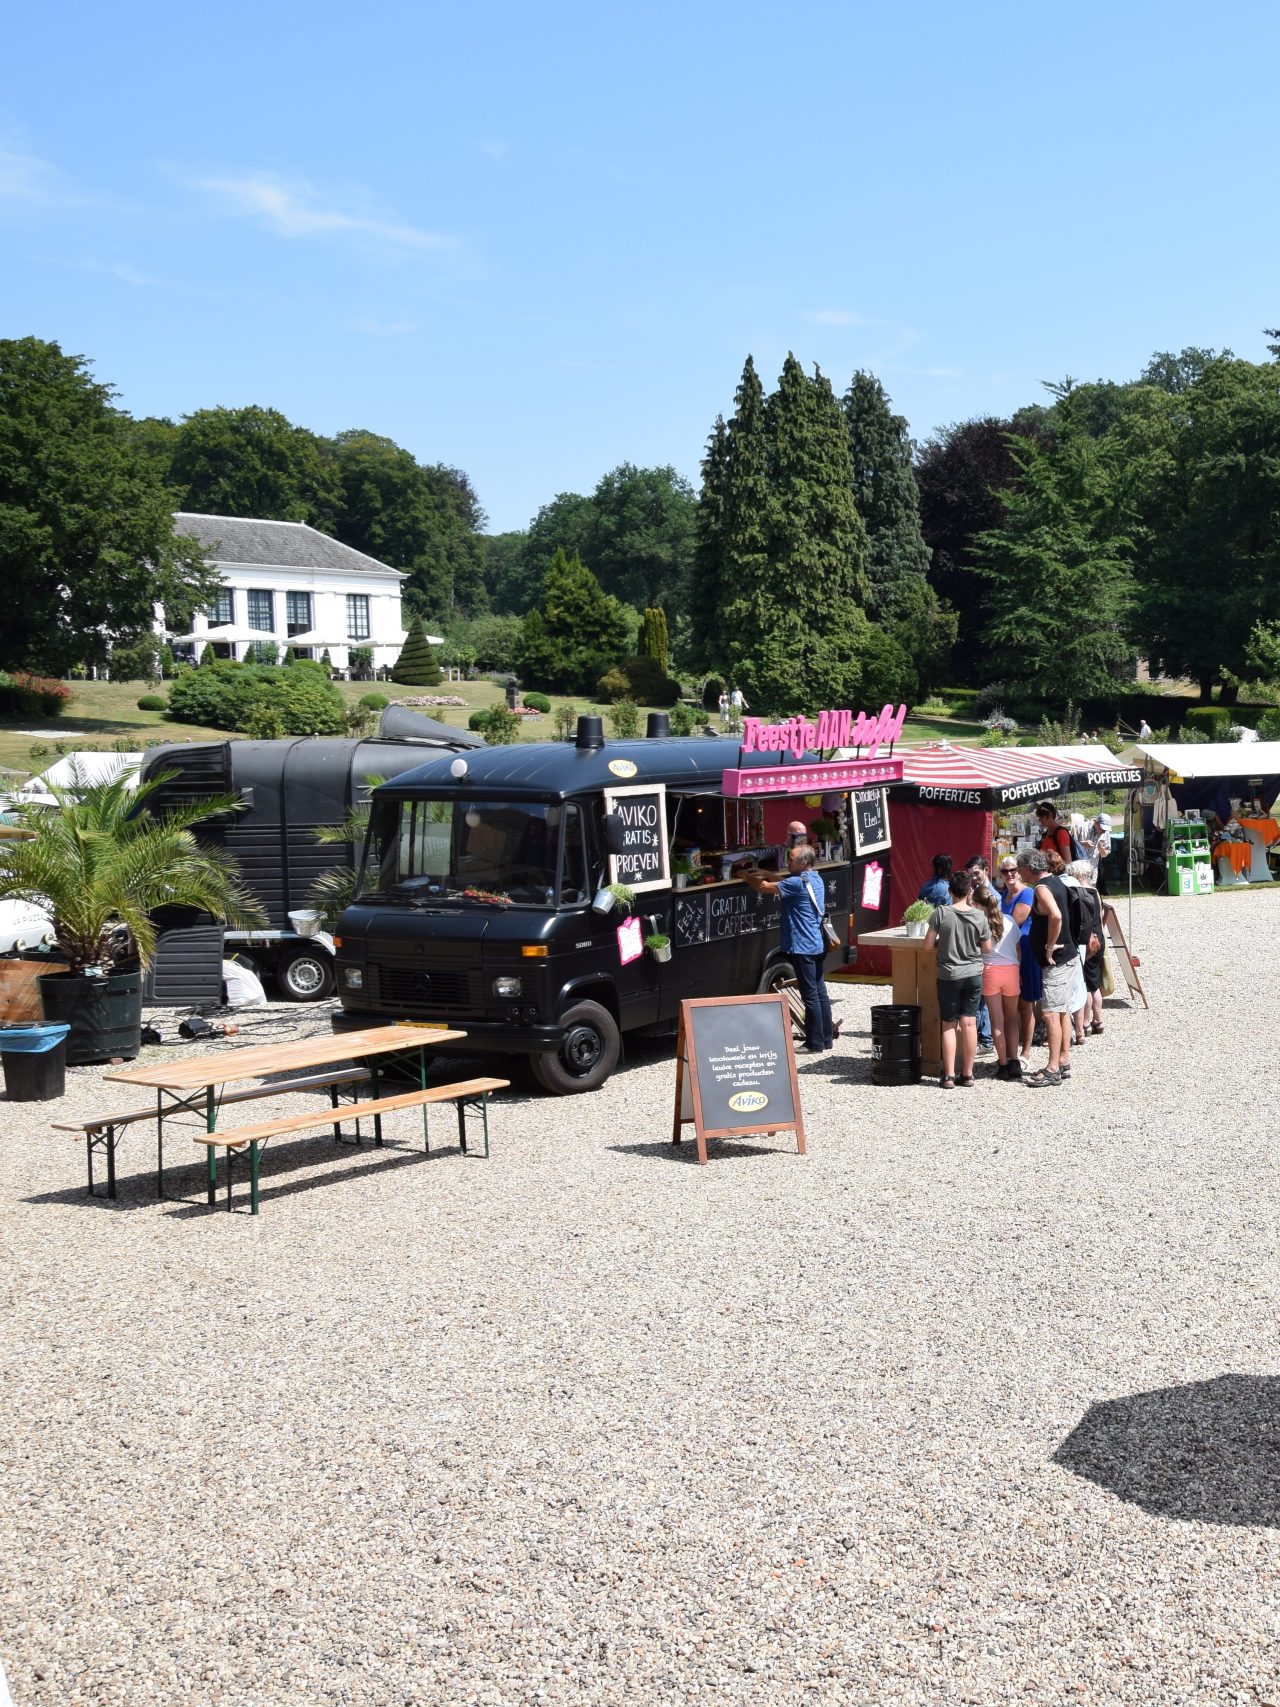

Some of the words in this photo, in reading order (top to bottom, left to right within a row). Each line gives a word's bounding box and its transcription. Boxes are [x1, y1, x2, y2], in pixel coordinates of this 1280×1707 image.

[741, 714, 816, 759] Feestje
[816, 710, 852, 749] AAN
[1087, 770, 1142, 785] POFFERTJES
[919, 786, 981, 805] POFFERTJES
[1001, 776, 1061, 802] POFFERTJES
[617, 805, 657, 827] AVIKO
[623, 829, 652, 847] RATIS
[616, 852, 659, 874] PROEVEN
[711, 895, 747, 917] GRATIN
[724, 1045, 740, 1053] Deel
[741, 1044, 760, 1054] jouw
[759, 1050, 778, 1060] krijg
[734, 1060, 765, 1071] recepten
[715, 1072, 737, 1082] gratis
[739, 1069, 775, 1081] producten
